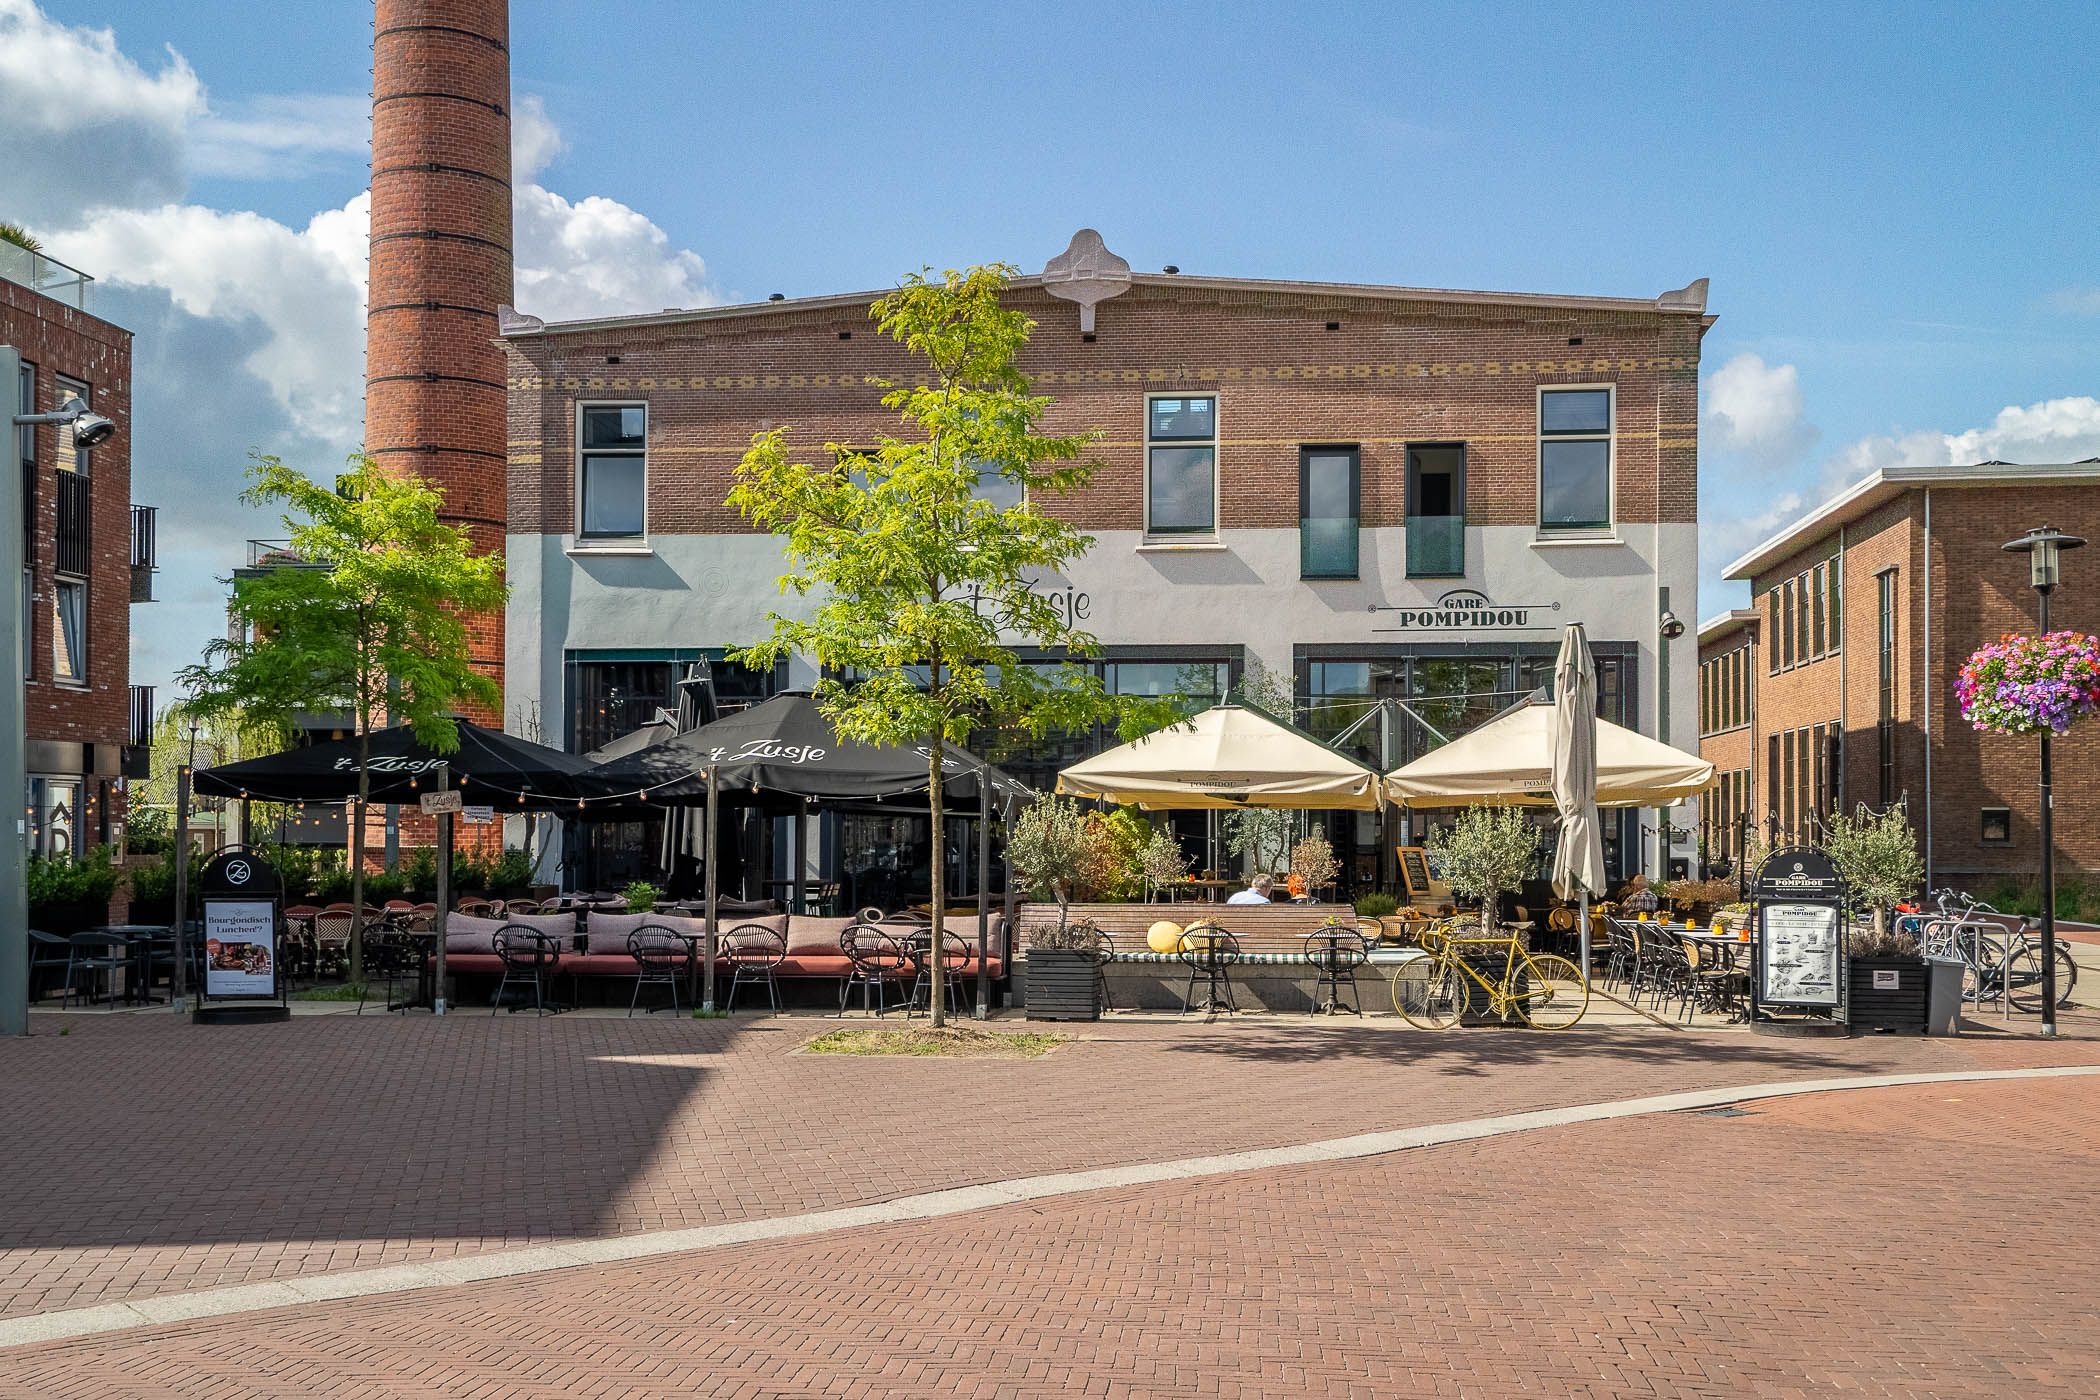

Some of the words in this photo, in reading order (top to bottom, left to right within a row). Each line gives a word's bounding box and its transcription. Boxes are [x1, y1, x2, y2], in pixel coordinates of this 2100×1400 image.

[994, 579, 1091, 632] Zsje
[1444, 598, 1484, 610] GARE
[1400, 610, 1528, 627] POMPIDOU
[710, 746, 727, 762] 't
[727, 739, 826, 764] Zusje
[350, 756, 449, 774] Zusje
[208, 916, 271, 925] Bourgondisch
